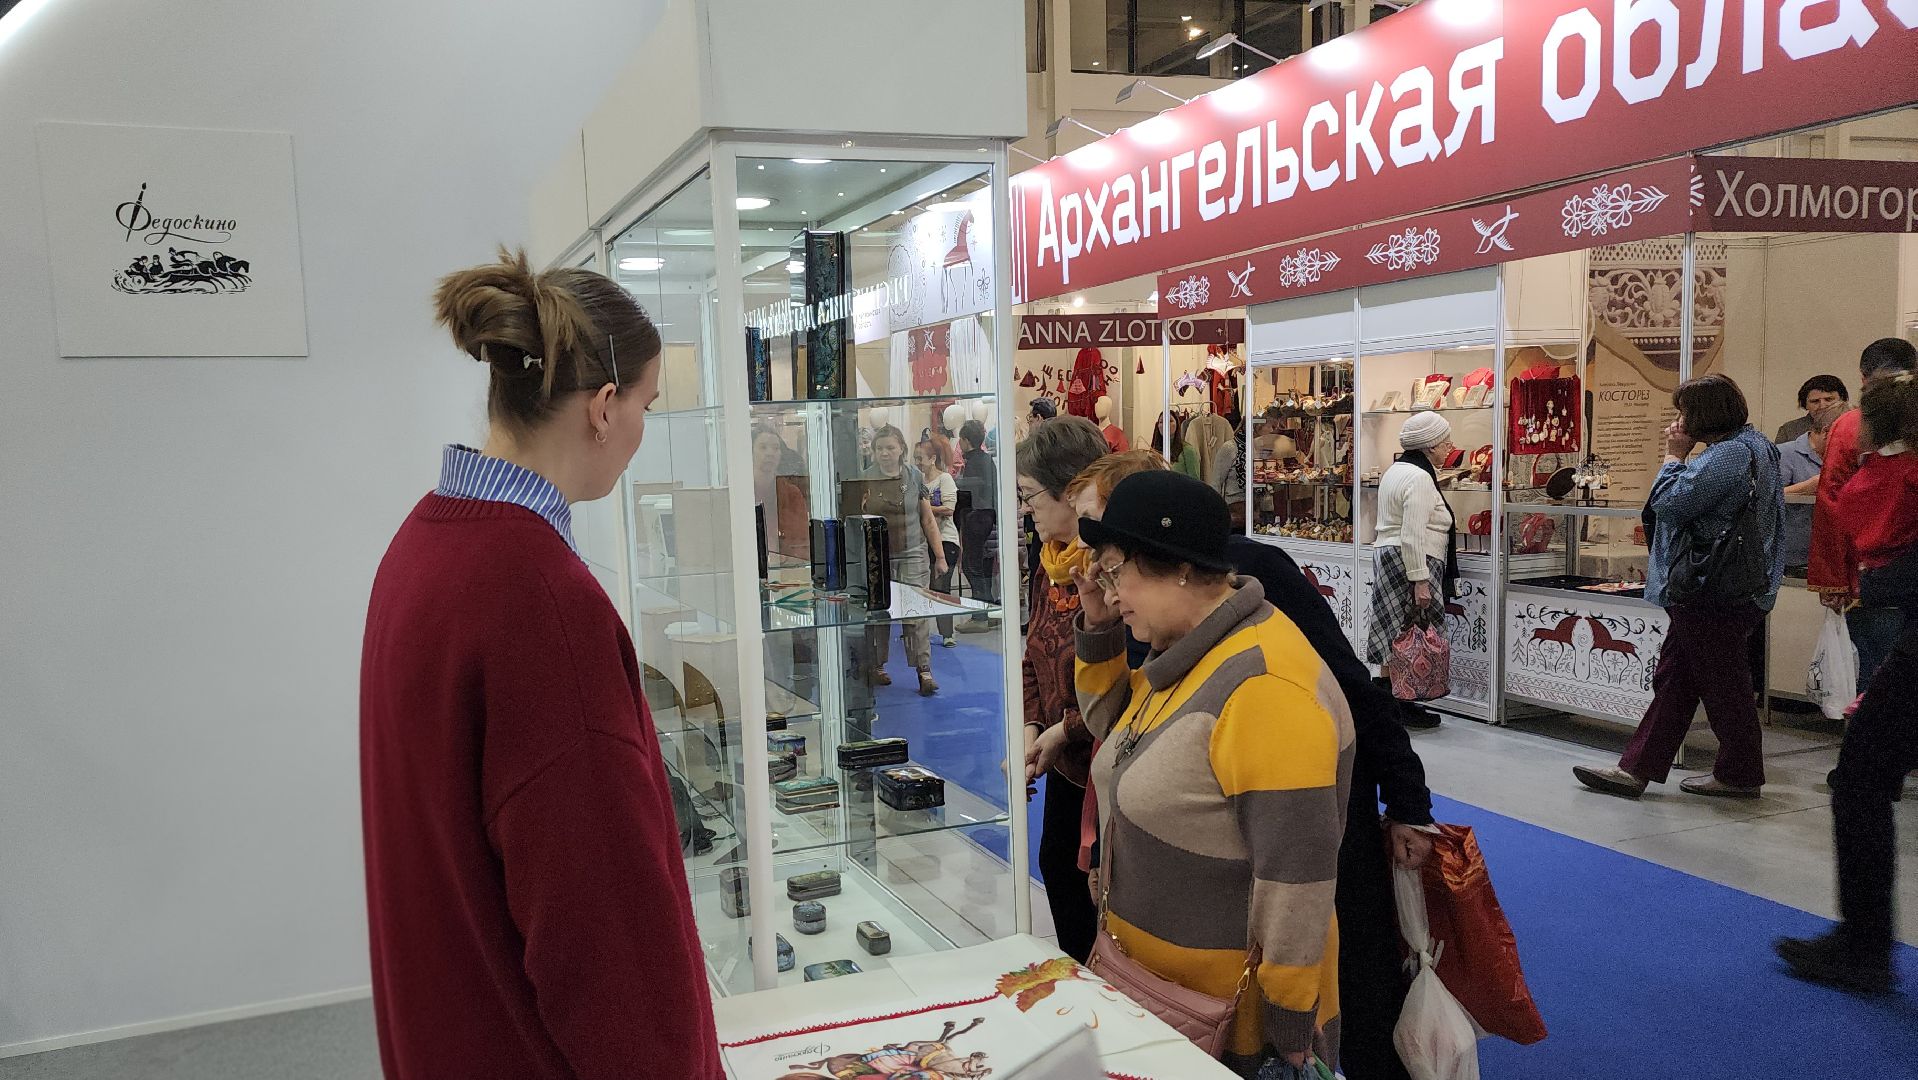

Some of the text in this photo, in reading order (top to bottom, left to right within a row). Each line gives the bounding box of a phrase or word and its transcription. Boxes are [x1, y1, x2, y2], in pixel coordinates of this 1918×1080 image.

[1037, 0, 1918, 284] Архангельская обла
[115, 182, 237, 244] Федоскино
[1018, 321, 1091, 345] ANNA
[1598, 389, 1650, 402] КОСТОРЕЗ
